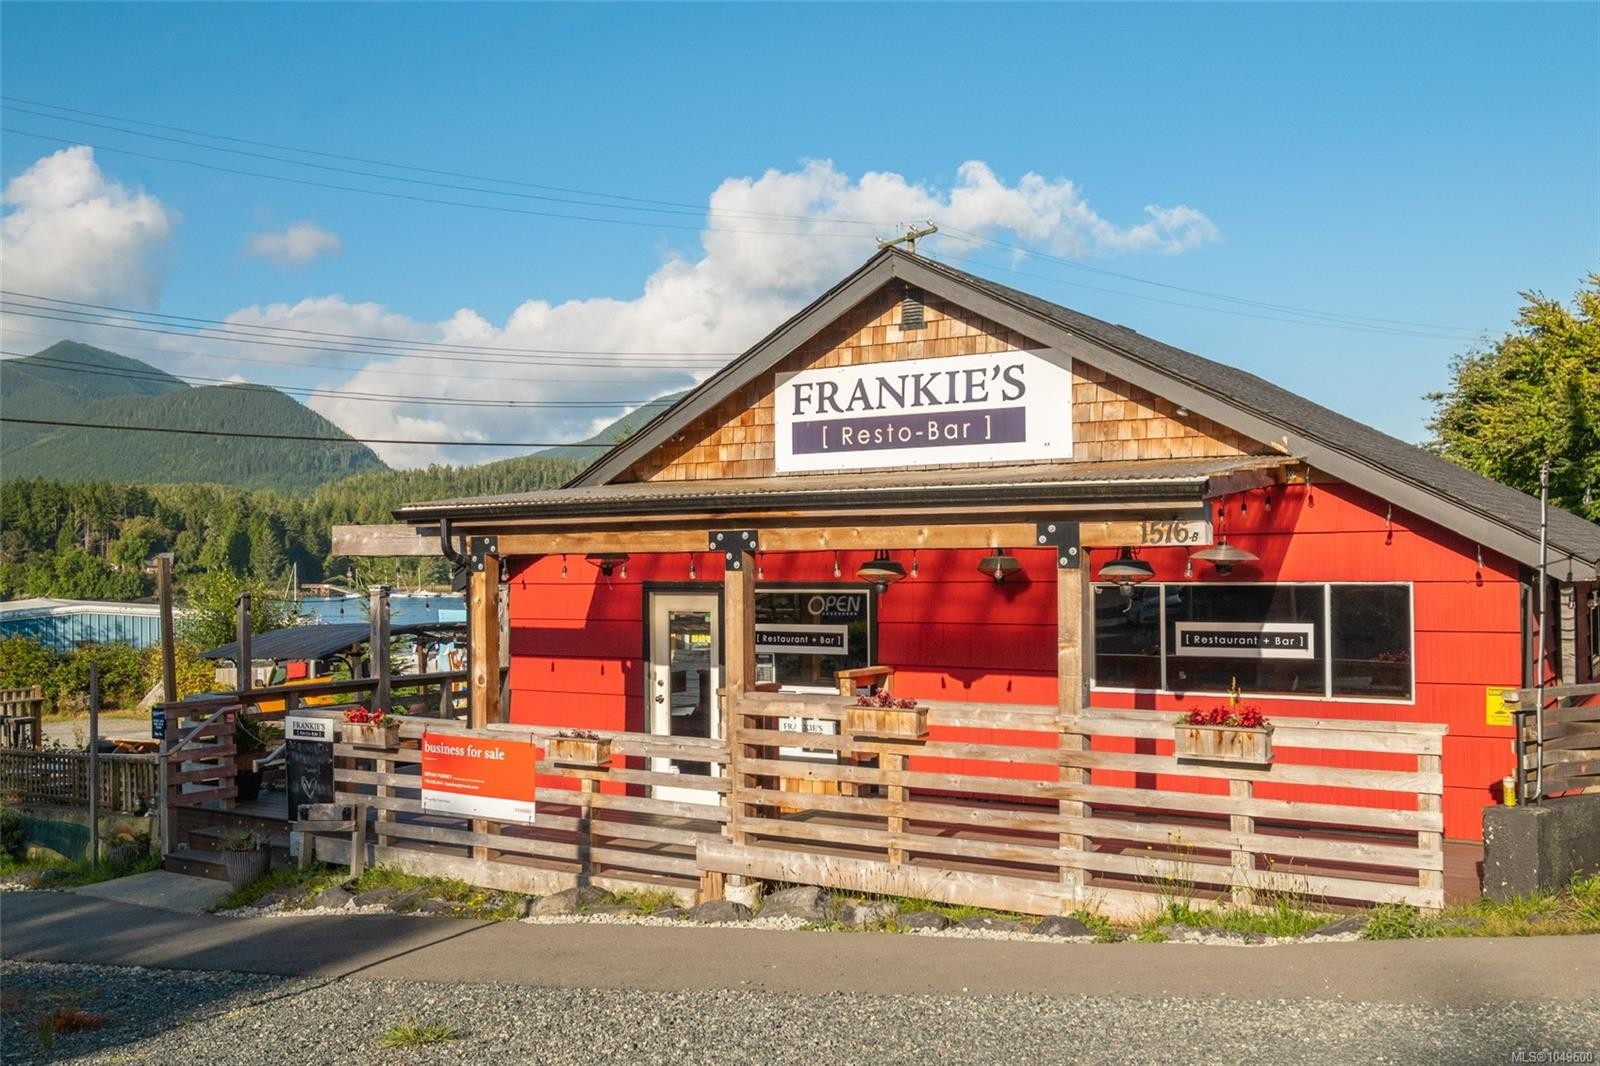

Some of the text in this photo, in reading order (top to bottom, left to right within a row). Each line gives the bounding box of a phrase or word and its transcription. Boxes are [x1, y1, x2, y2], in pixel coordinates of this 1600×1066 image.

[791, 363, 1026, 416] FRANKIE'S
[841, 420, 971, 446] Resto-Bar
[807, 595, 861, 615] OPEN
[762, 633, 808, 644] Restaurant
[820, 636, 835, 645] Bar
[1193, 634, 1258, 645] Restaurant
[1275, 636, 1295, 646] Bar
[424, 741, 505, 760] business for sale
